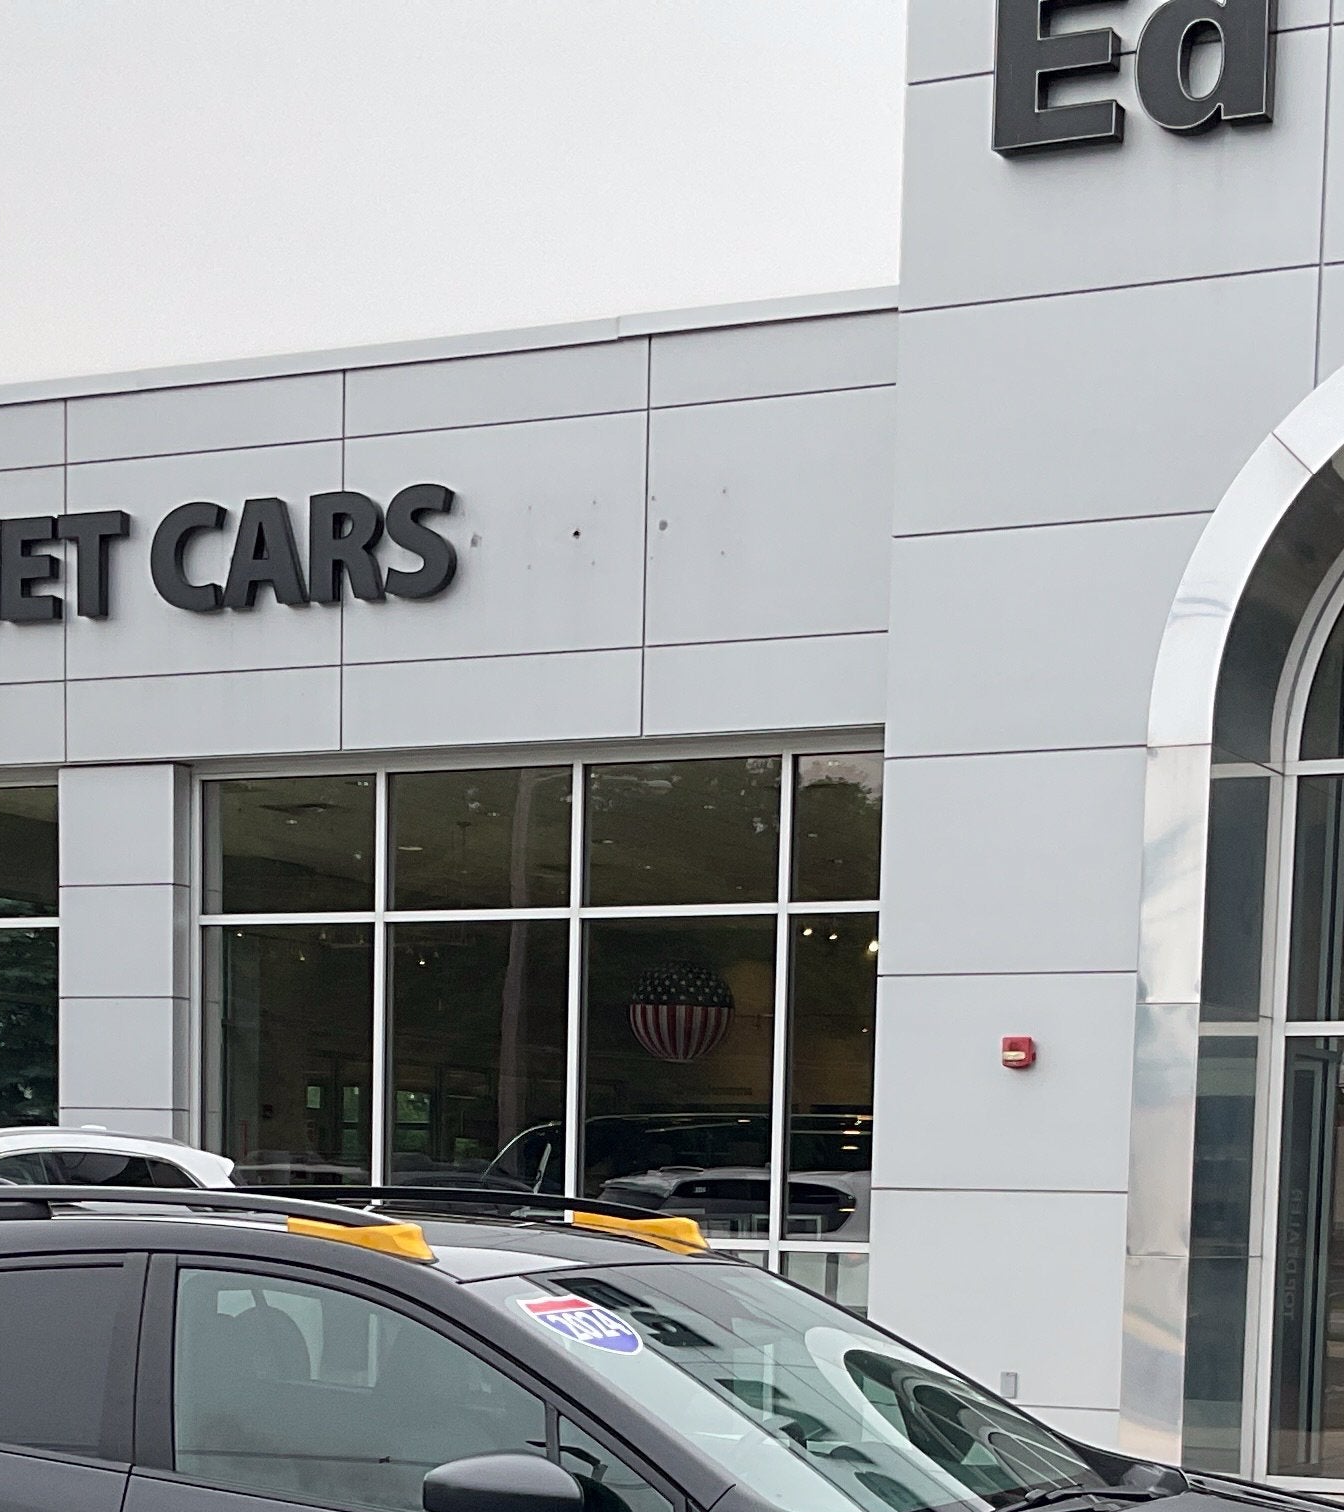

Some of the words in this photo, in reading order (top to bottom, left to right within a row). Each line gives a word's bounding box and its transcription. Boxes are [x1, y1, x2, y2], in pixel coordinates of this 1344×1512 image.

[991, 0, 1274, 155] Ed
[150, 482, 459, 612] CARS
[547, 1309, 632, 1340] 2024
